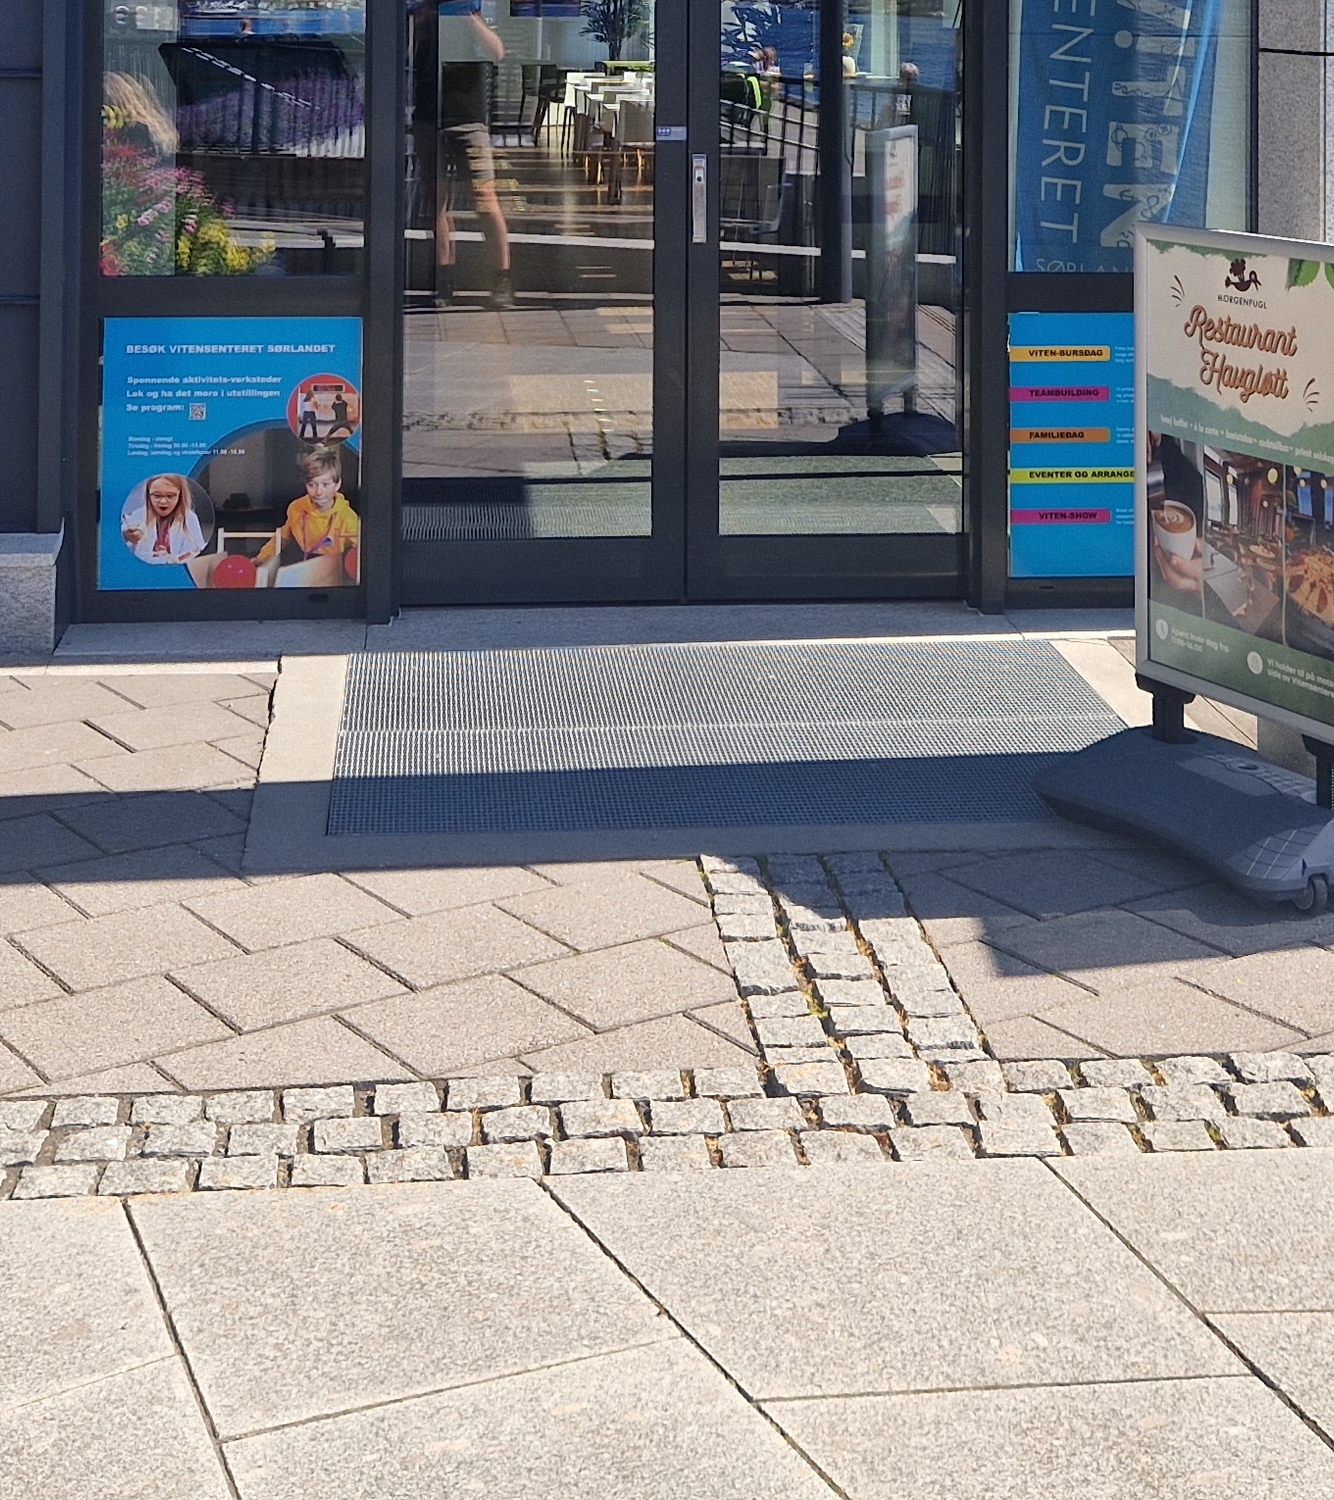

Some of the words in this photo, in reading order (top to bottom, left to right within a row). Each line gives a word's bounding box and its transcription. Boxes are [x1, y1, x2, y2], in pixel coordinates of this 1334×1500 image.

[1218, 294, 1267, 310] MORGENFUGL
[1184, 305, 1298, 357] Restaurant
[126, 345, 166, 354] BESØK
[169, 345, 264, 354] VITENSENTERET
[267, 345, 336, 354] SØRLANDET
[1029, 349, 1104, 357] VITEN-BURSDAG
[147, 391, 159, 399] og
[1029, 389, 1099, 397] TEAMBUILDING
[1029, 431, 1085, 439] FAMILIEDAG
[1074, 470, 1088, 478] OG
[1038, 512, 1097, 520] VITEN-SHOW
